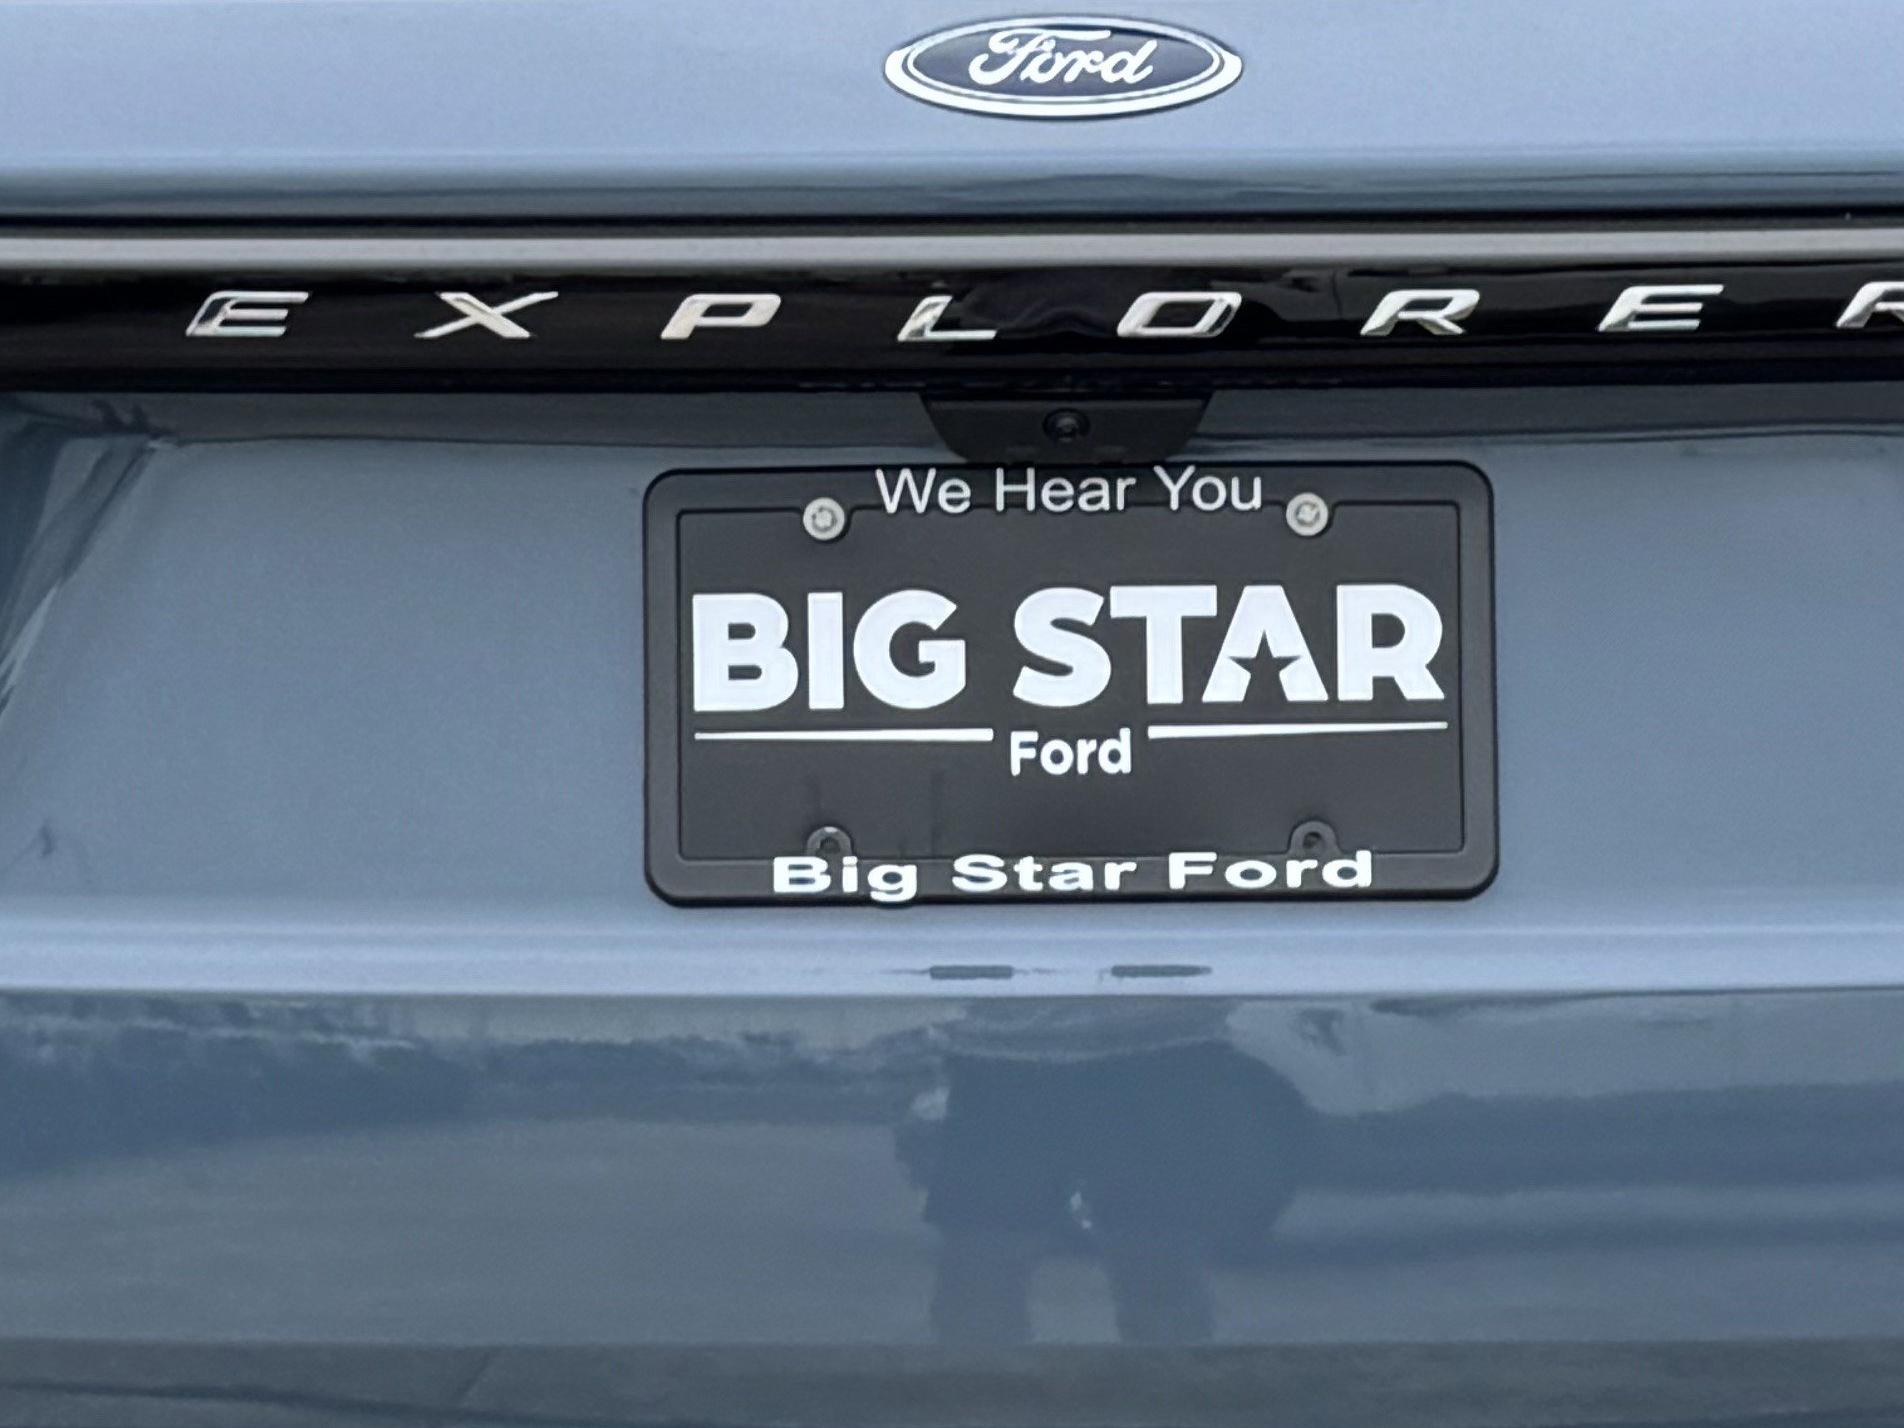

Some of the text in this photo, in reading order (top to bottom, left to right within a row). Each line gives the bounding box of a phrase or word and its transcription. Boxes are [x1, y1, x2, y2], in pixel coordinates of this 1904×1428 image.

[968, 28, 1157, 85] Ford
[875, 465, 1262, 514] We Hear You
[692, 584, 1445, 712] BIG STAR
[1010, 727, 1132, 776] Ford
[772, 851, 1373, 903] Big Star Ford
